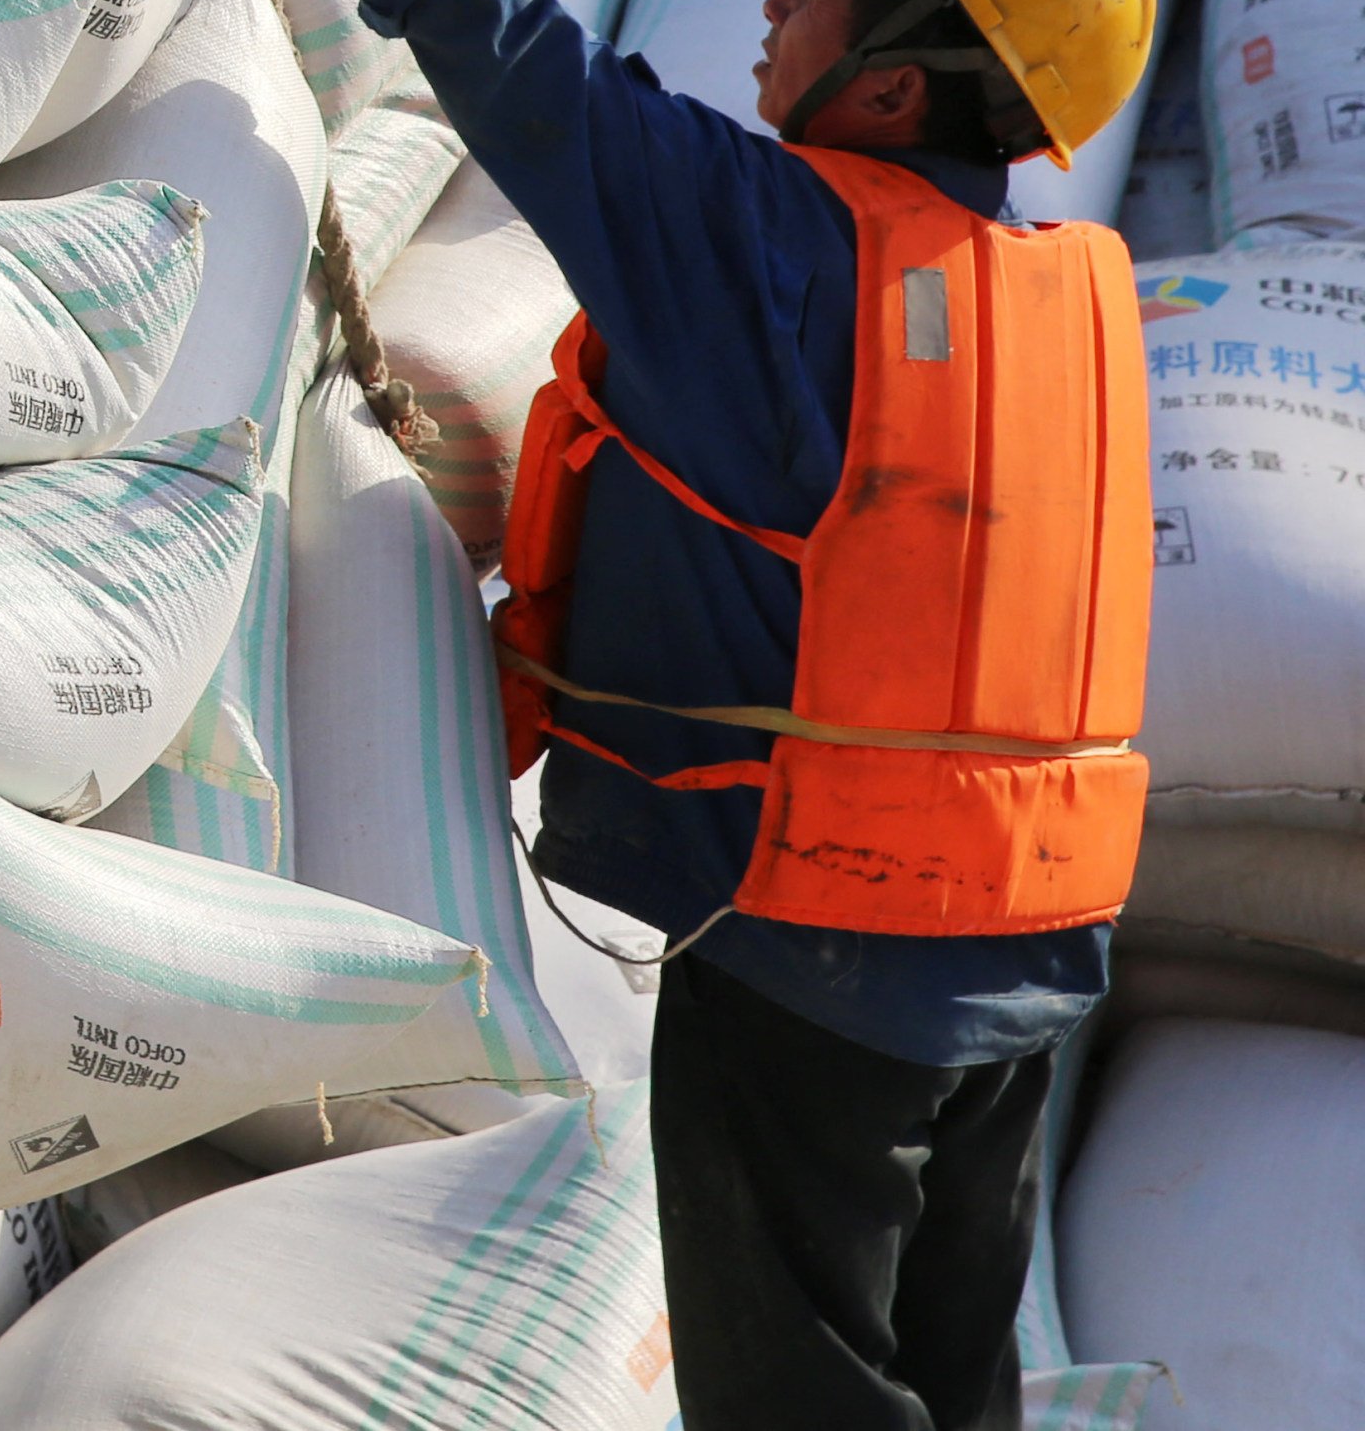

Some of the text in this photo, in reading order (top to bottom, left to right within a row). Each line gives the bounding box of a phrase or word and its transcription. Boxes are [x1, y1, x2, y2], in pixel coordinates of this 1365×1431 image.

[1260, 295, 1365, 324] COFC
[5, 360, 86, 403] COFCO INTL
[7, 390, 85, 438] 中粮国际
[49, 682, 153, 716] 中粮国际
[73, 1014, 186, 1067] COFCO INTL
[67, 1043, 181, 1091] 中粮国际
